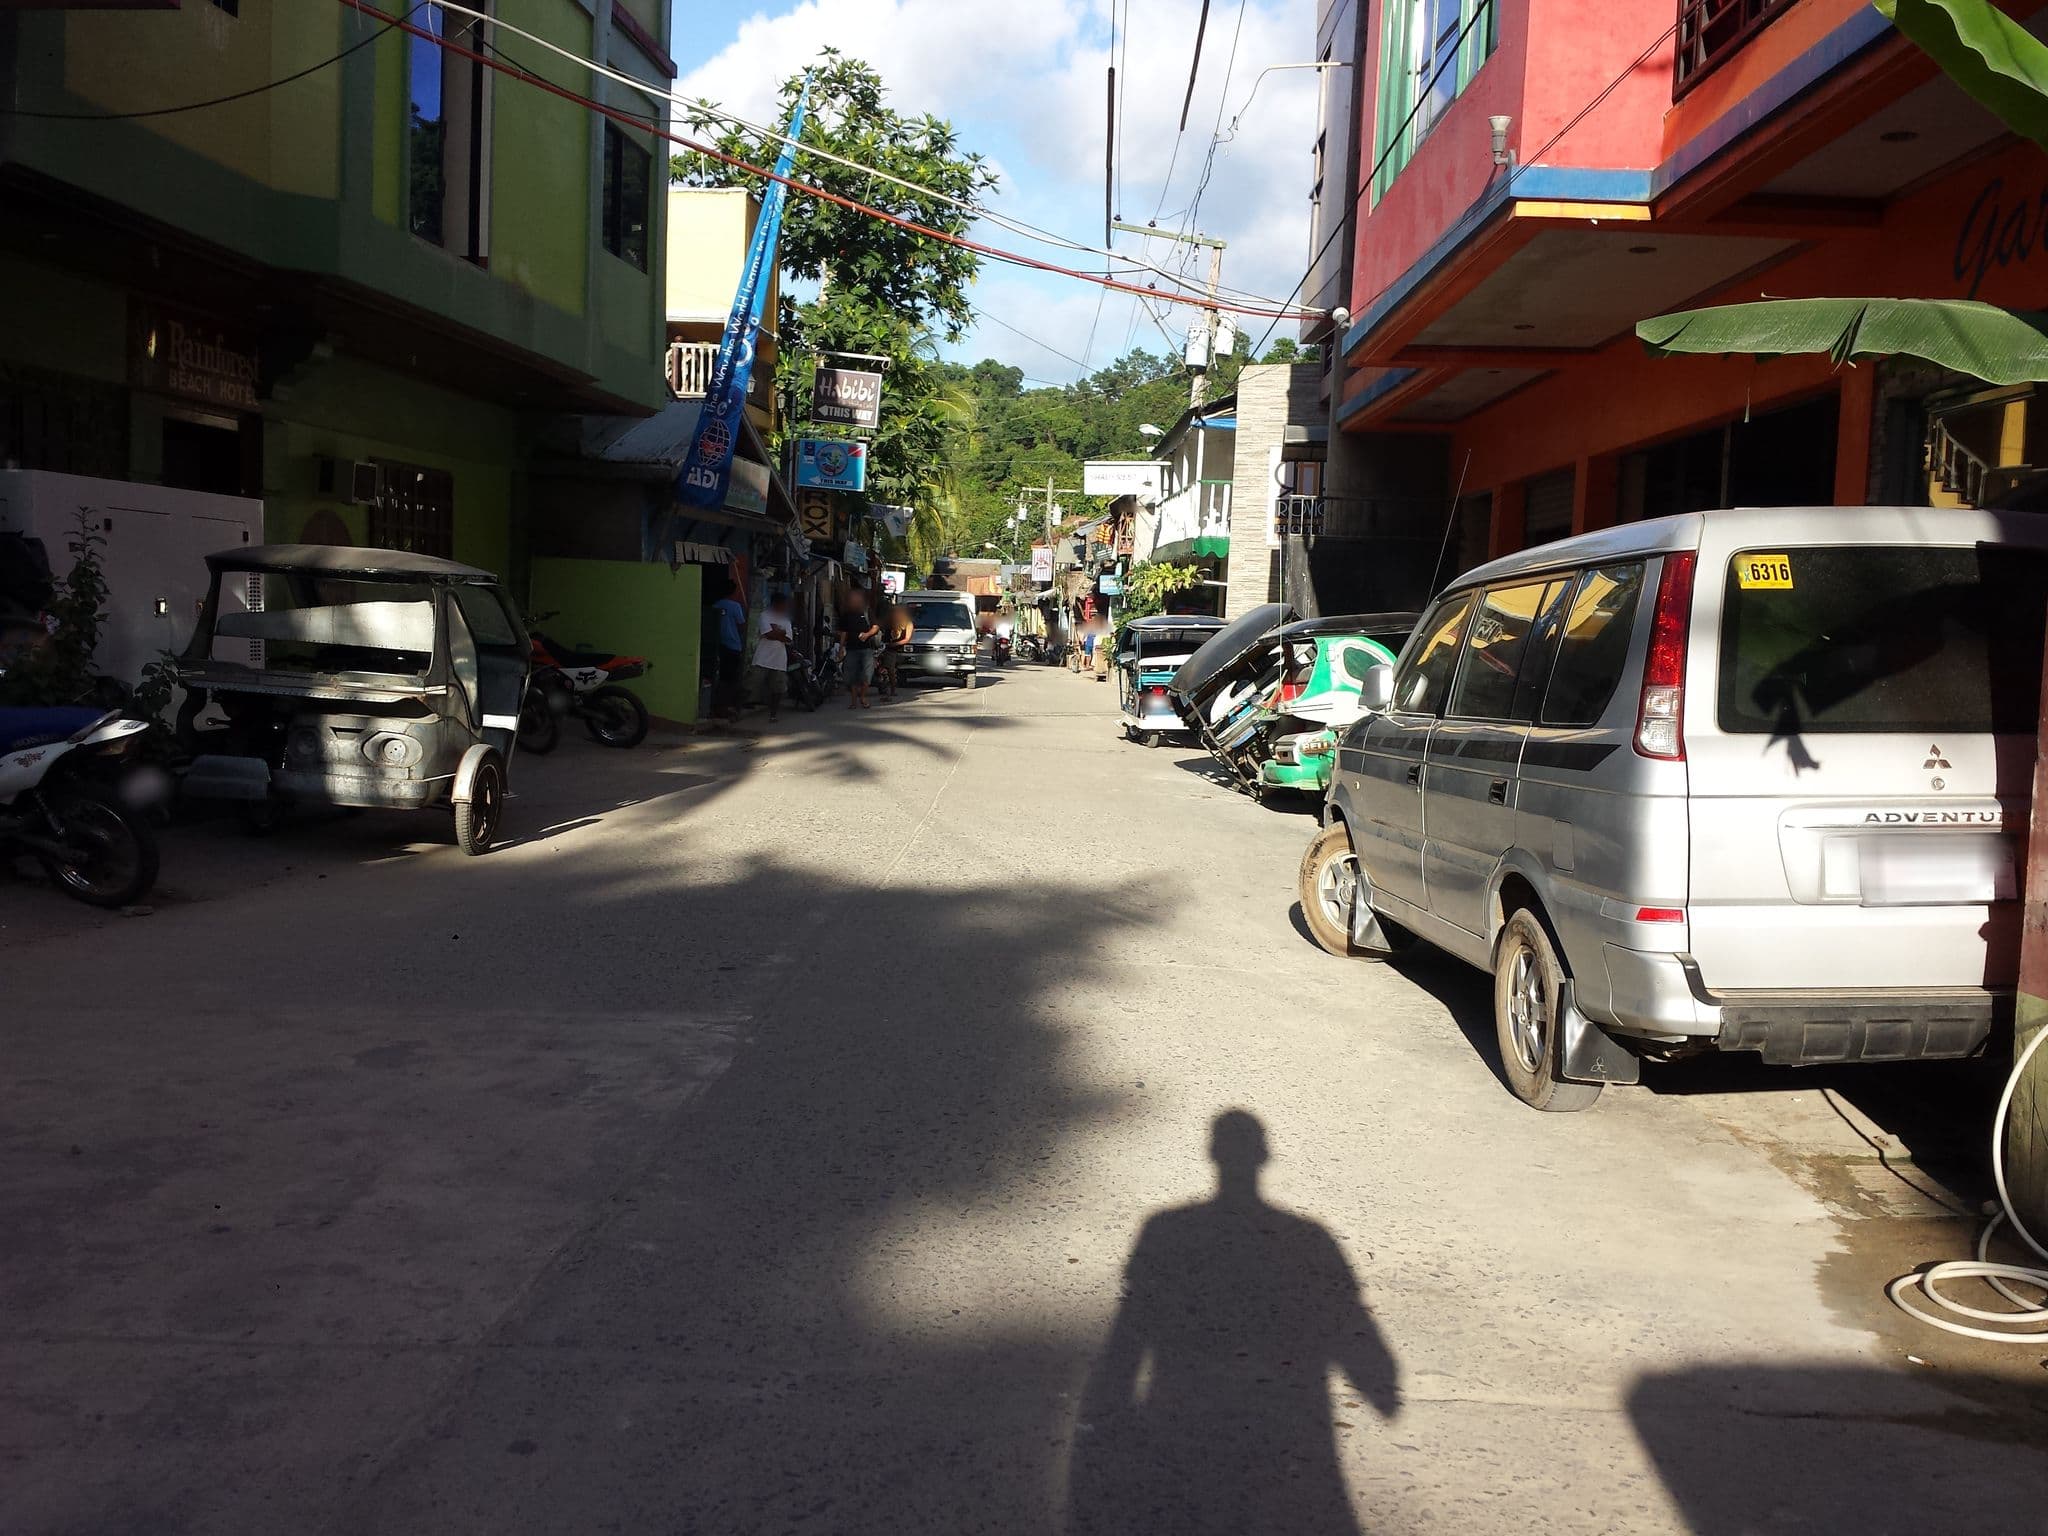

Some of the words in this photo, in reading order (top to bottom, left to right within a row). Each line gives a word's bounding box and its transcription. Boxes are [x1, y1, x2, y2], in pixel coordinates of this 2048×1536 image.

[168, 319, 263, 383] Rainforest
[168, 368, 210, 395] BEACH
[219, 380, 260, 408] HOTEL
[819, 375, 875, 402] Habibi
[704, 394, 719, 414] The
[827, 405, 851, 419] THIS
[852, 409, 873, 421] WAY
[1750, 563, 1789, 581] 6316
